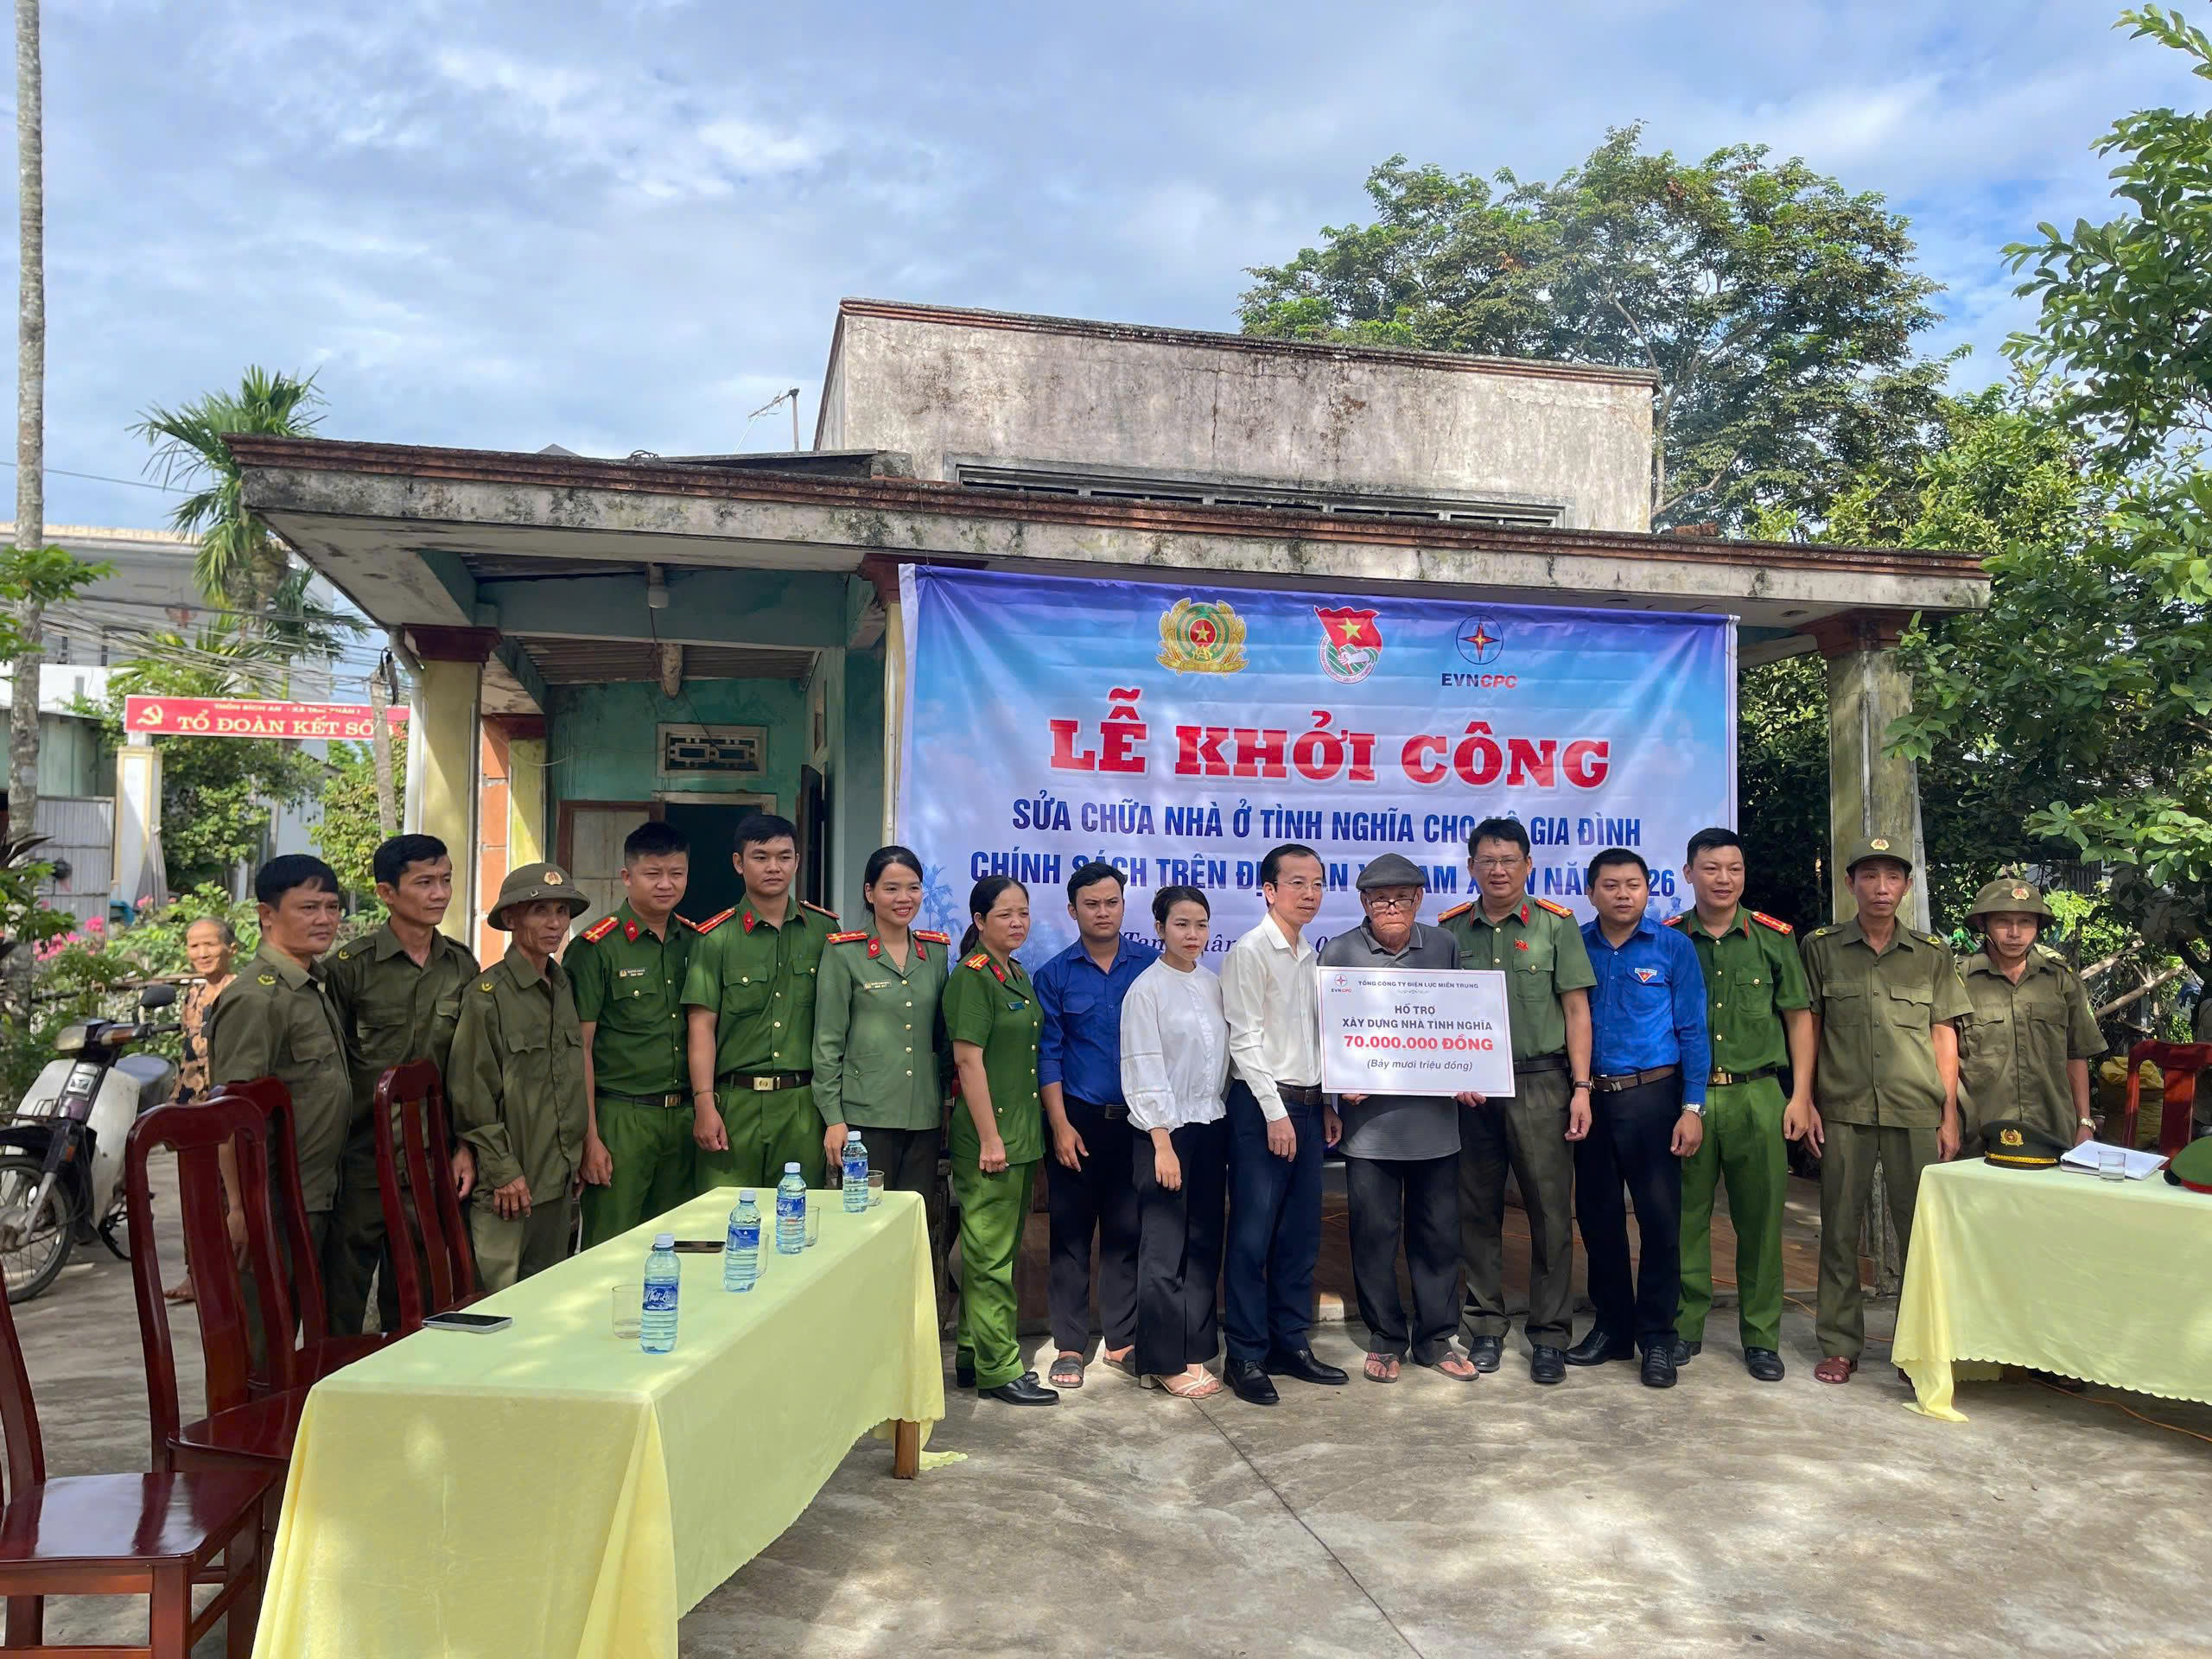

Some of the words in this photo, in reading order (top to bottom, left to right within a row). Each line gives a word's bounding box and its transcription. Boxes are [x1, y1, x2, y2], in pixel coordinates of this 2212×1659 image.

[1441, 672, 1519, 690] EVNCPC
[177, 709, 210, 731] TỔ
[217, 715, 285, 734] ĐOÀN
[292, 715, 340, 734] KẾT
[1049, 688, 1149, 773] LỄ
[1174, 710, 1376, 782] KHỞI
[1401, 721, 1609, 788] CÔNG
[1013, 790, 1071, 830] SỬA
[1081, 798, 1155, 835] CHỮA
[1165, 801, 1224, 836] NHÀ
[1232, 798, 1252, 838] Ở
[1261, 804, 1323, 840] TÌNH
[1332, 807, 1414, 842] NGHĨA
[1424, 814, 1475, 844] CHO
[1530, 816, 1569, 845] GIA
[1577, 811, 1641, 846] ĐÌNH
[970, 846, 1061, 884] CHÍNH
[1155, 853, 1232, 890] TRÊN
[1236, 861, 1262, 897] ĐỊ
[1648, 869, 1675, 897] 26
[1414, 1005, 1436, 1016] TRỢ
[1342, 1016, 1364, 1027] XÂY
[1368, 1018, 1398, 1029] DỰNG
[1402, 1019, 1425, 1029] NHÀ
[1427, 1020, 1454, 1030] TÌNH
[1344, 1035, 1439, 1050] 70.000.000
[1441, 1033, 1494, 1051] ĐỒNG
[1419, 1060, 1441, 1070] triệu
